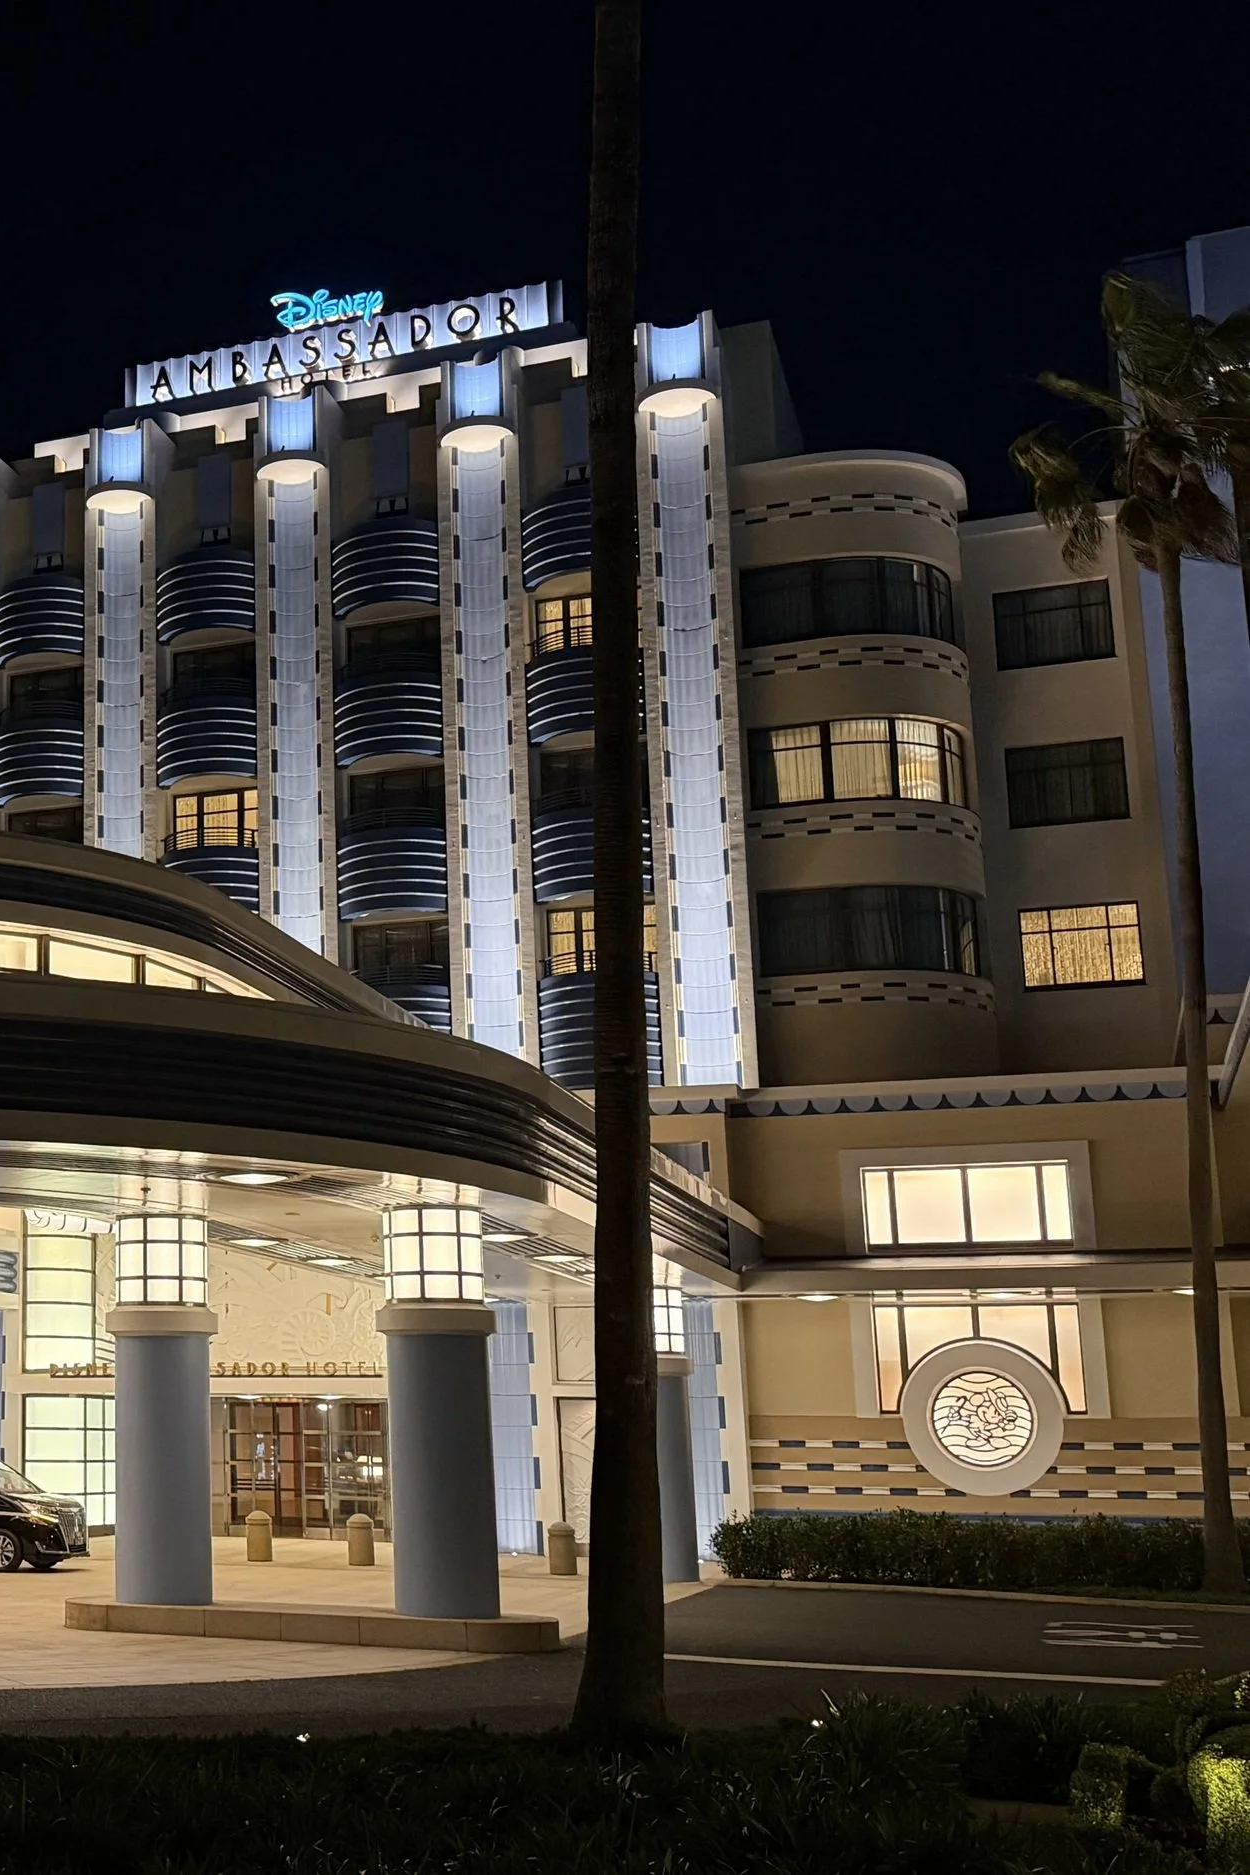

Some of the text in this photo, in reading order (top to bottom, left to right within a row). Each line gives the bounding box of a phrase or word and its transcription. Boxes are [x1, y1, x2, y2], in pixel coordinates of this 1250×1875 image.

[150, 297, 520, 400] AMBASSADOR
[280, 362, 372, 391] HOTEL
[49, 1361, 379, 1376] DISNE SADOR HOTEL
